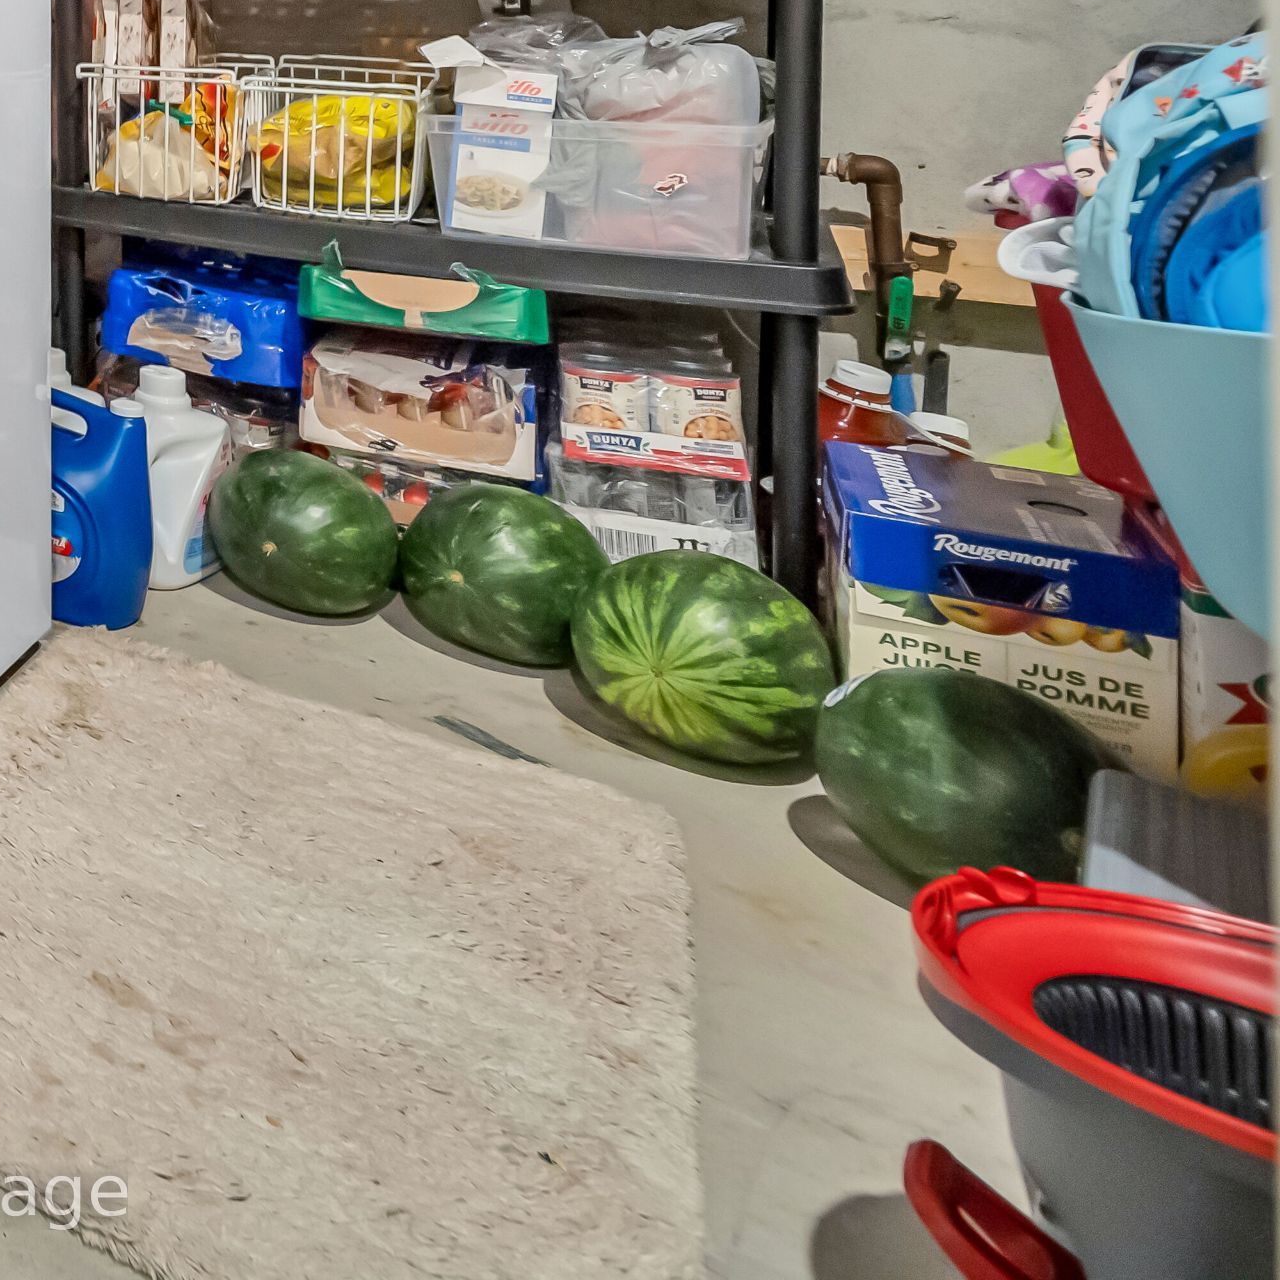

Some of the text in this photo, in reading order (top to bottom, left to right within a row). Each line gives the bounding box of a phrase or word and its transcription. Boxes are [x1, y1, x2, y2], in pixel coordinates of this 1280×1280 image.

[582, 377, 611, 388] DUNYA
[695, 389, 725, 397] DUNYA
[591, 434, 637, 448] DUNYA
[862, 448, 942, 524] Rougemont
[934, 533, 1073, 573] Rougemont
[878, 632, 982, 668] APPLE
[1020, 662, 1145, 700] JUS DE
[1016, 679, 1151, 721] POMME
